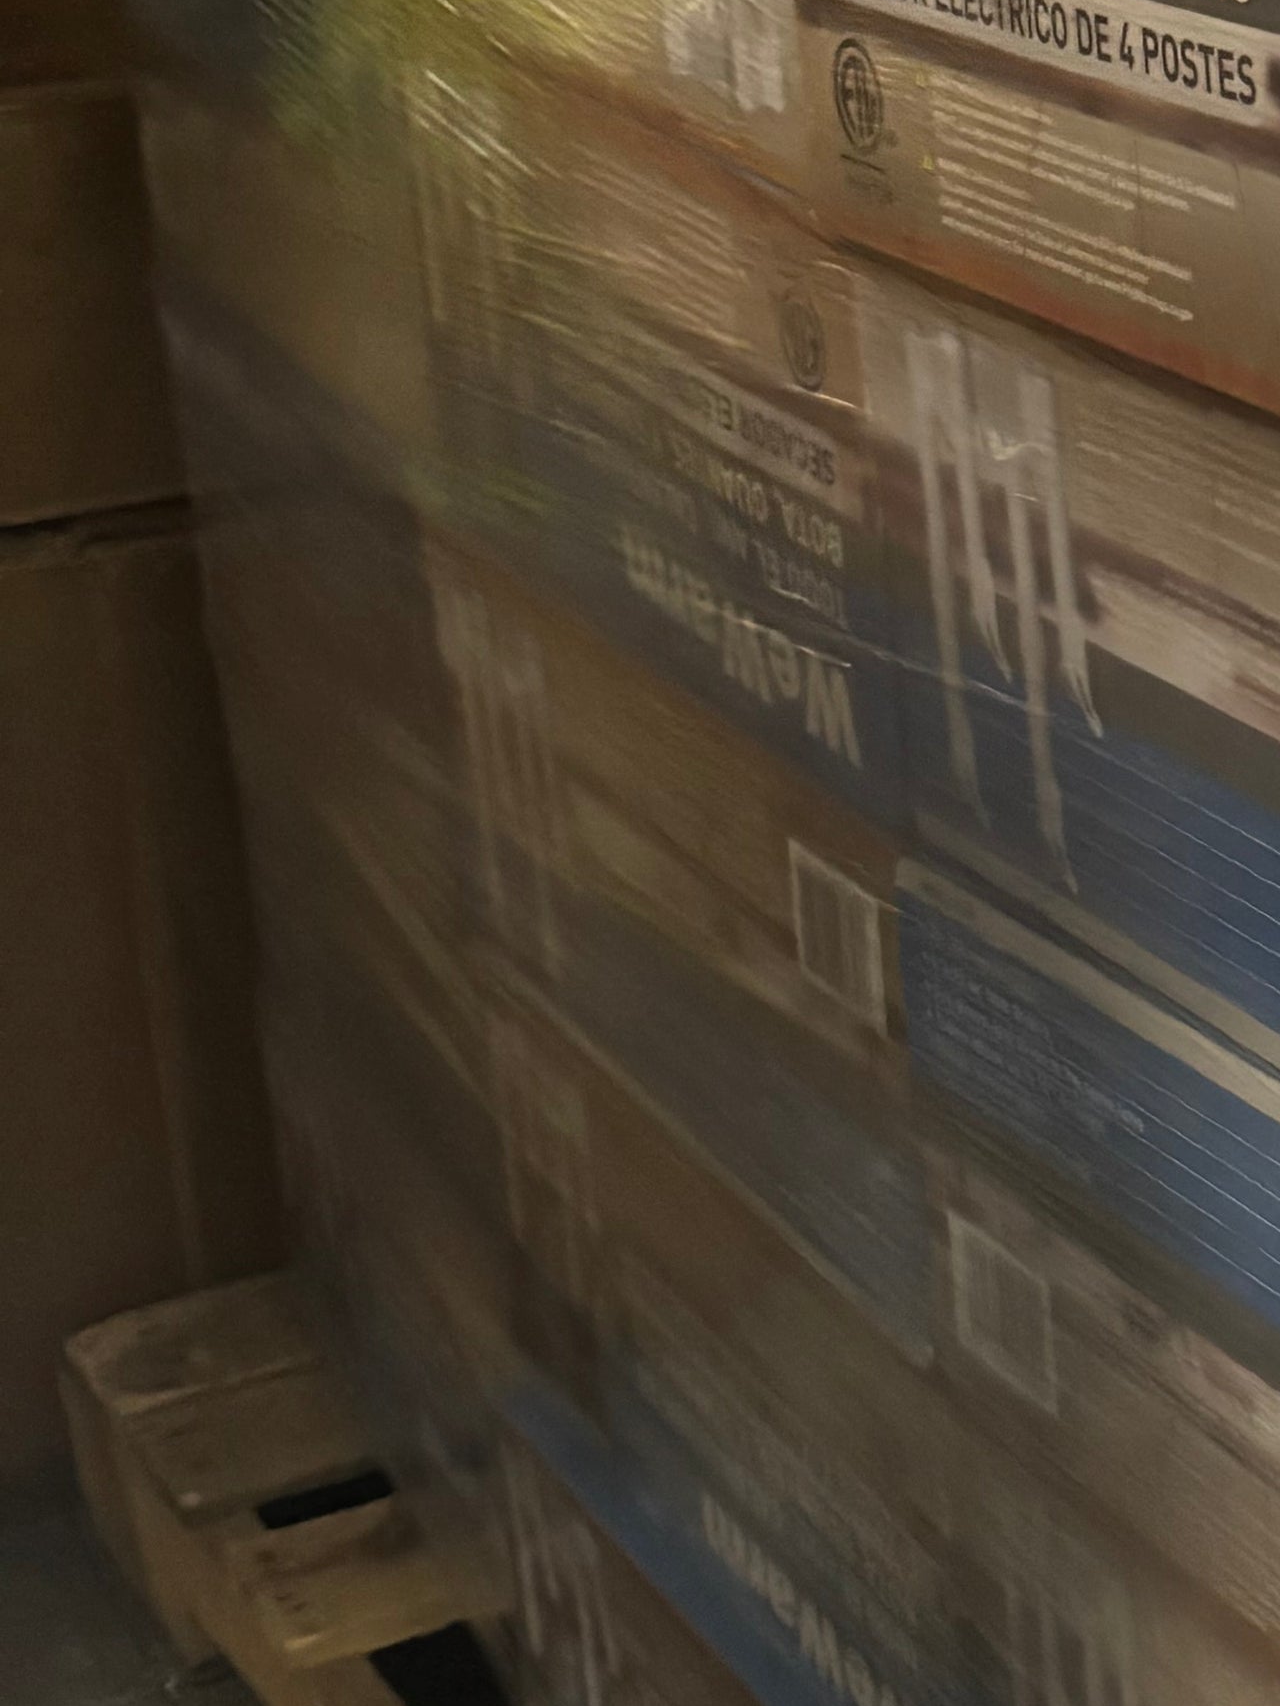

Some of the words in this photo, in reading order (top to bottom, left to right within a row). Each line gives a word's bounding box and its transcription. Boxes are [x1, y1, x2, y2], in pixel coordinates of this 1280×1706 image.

[1075, 11, 1114, 65] DE
[1118, 21, 1136, 71] 4
[1142, 27, 1258, 106] POSTES
